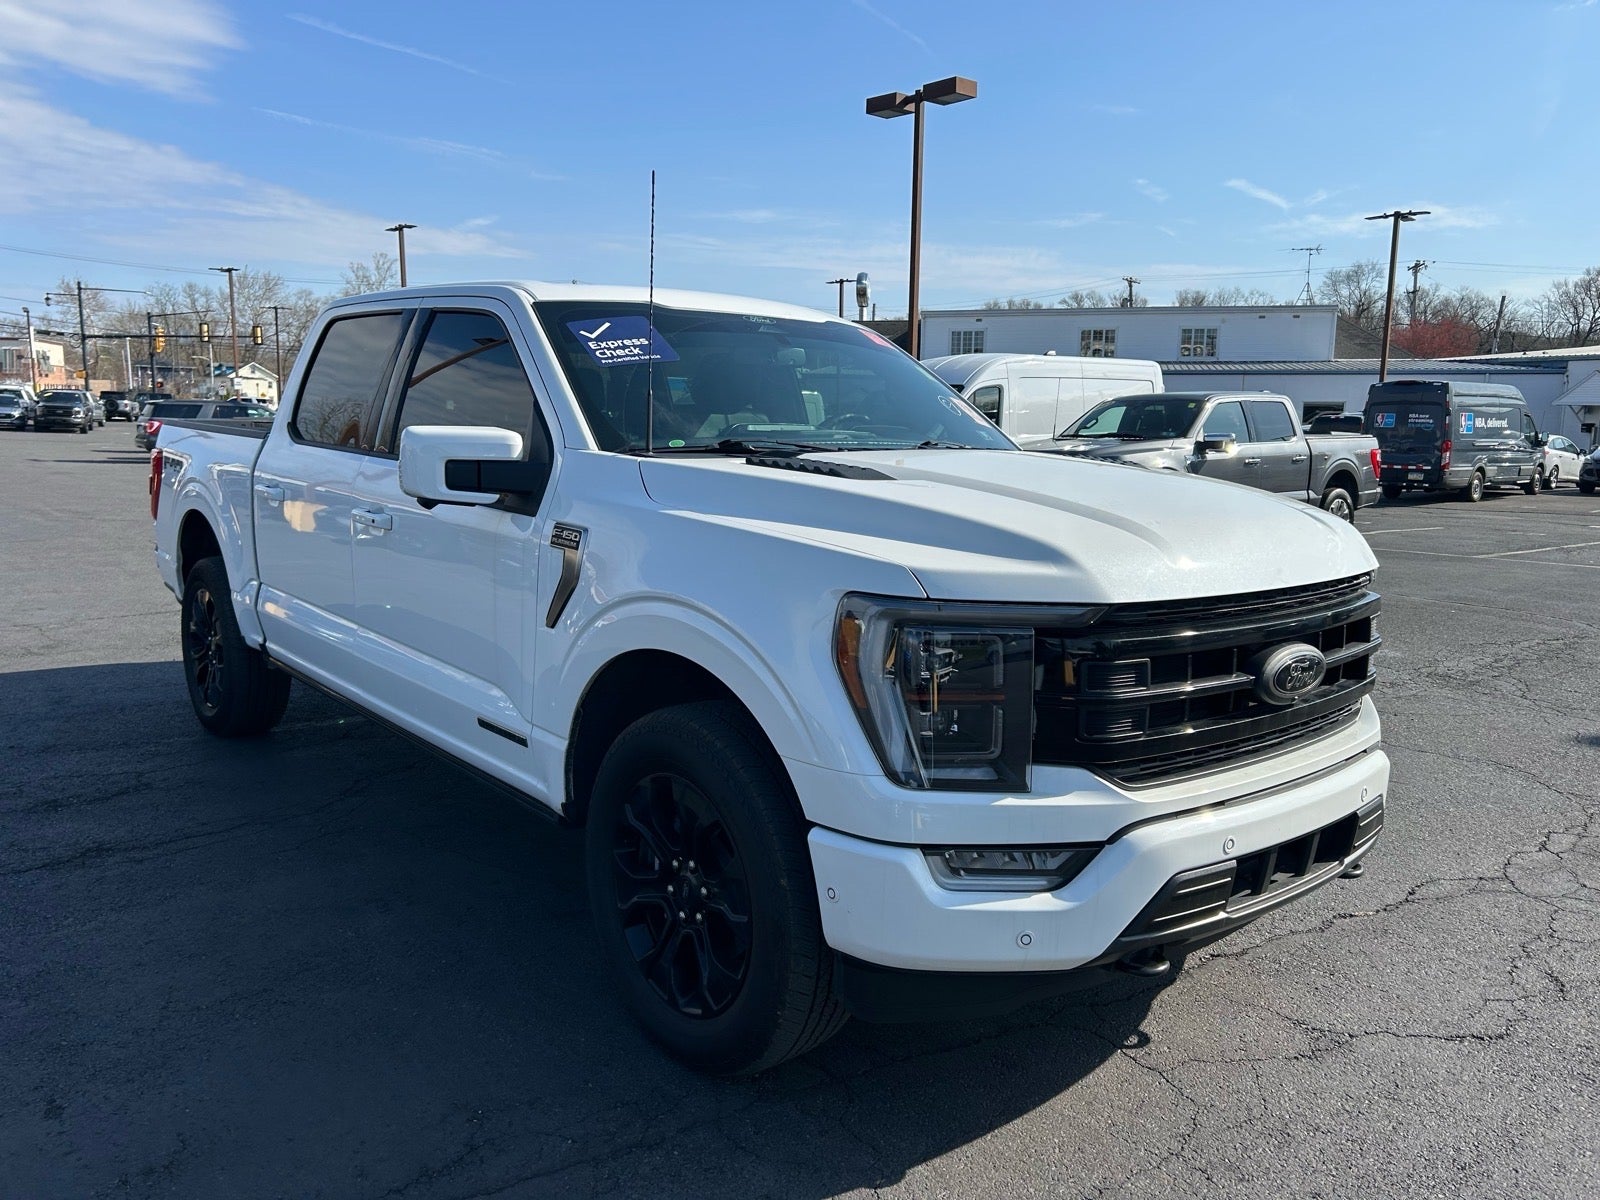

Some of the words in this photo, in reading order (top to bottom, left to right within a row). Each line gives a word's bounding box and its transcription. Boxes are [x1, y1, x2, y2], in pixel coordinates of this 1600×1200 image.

[588, 338, 649, 349] Express
[595, 346, 643, 358] Check
[1475, 417, 1487, 429] NBA,
[1487, 417, 1508, 428] delivered.
[552, 529, 579, 541] F-150
[1286, 661, 1316, 689] Ford
